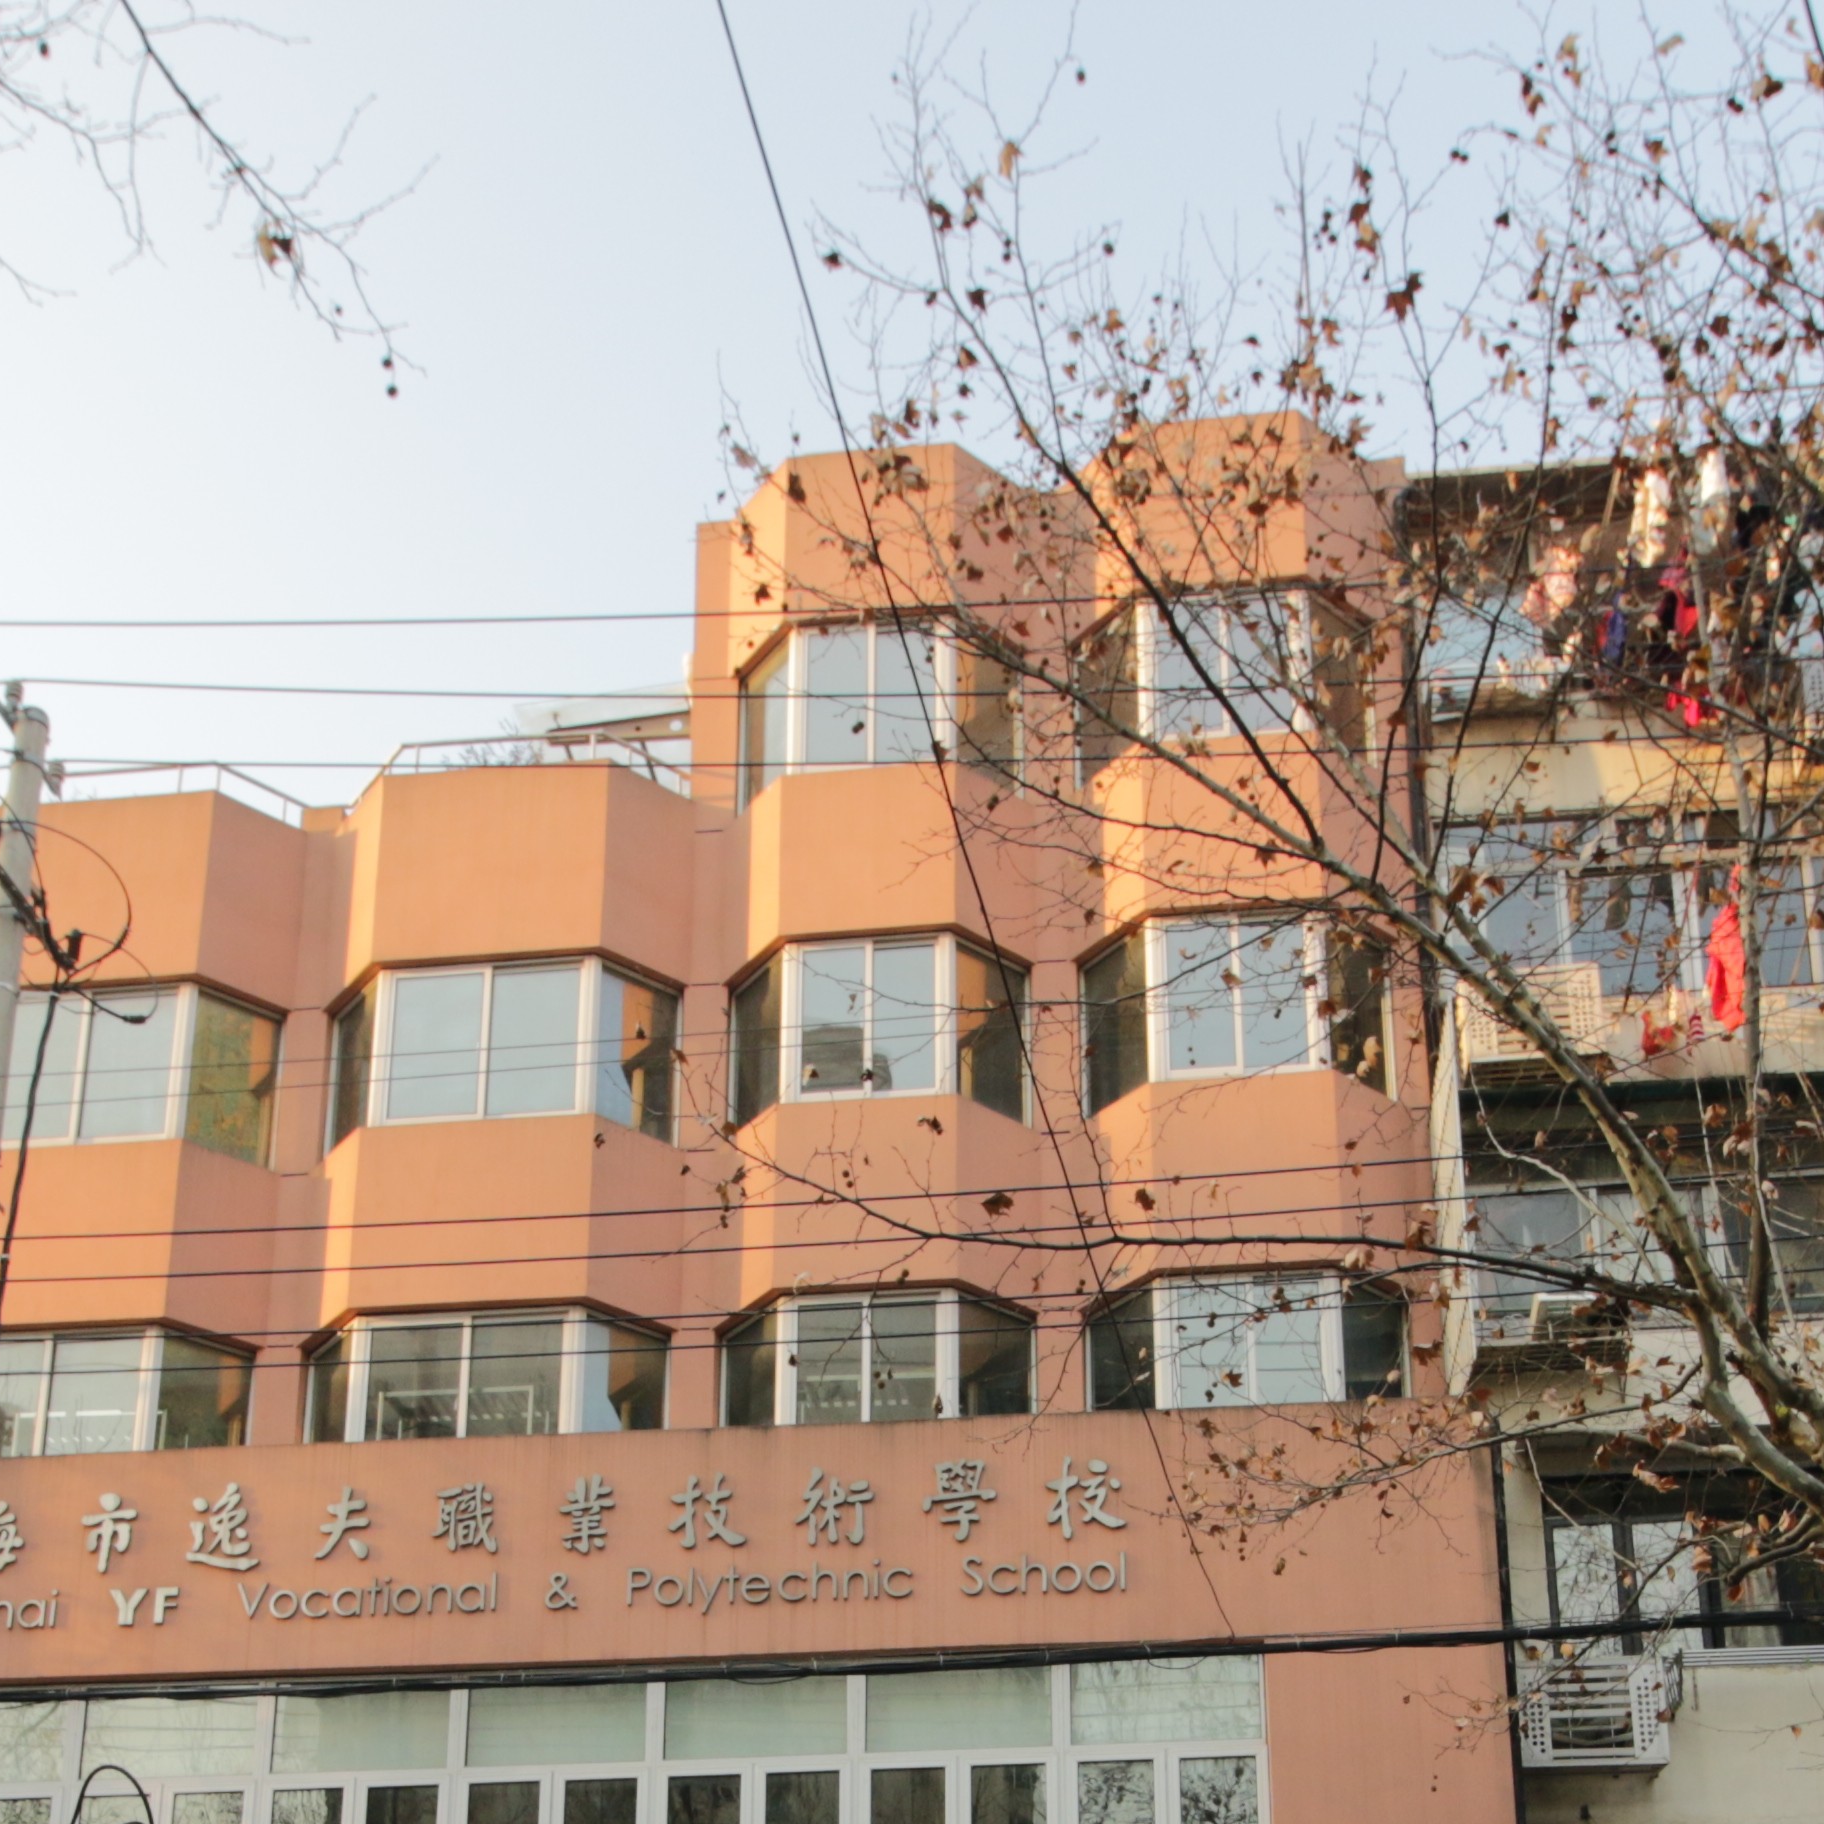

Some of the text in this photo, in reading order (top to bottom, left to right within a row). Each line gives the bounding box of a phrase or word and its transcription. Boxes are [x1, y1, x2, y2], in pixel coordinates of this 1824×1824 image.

[109, 1585, 181, 1627] YF
[238, 1574, 499, 1621] Vocational
[545, 1575, 578, 1611] &
[628, 1560, 914, 1615] Polytechnic
[962, 1552, 1129, 1598] School
